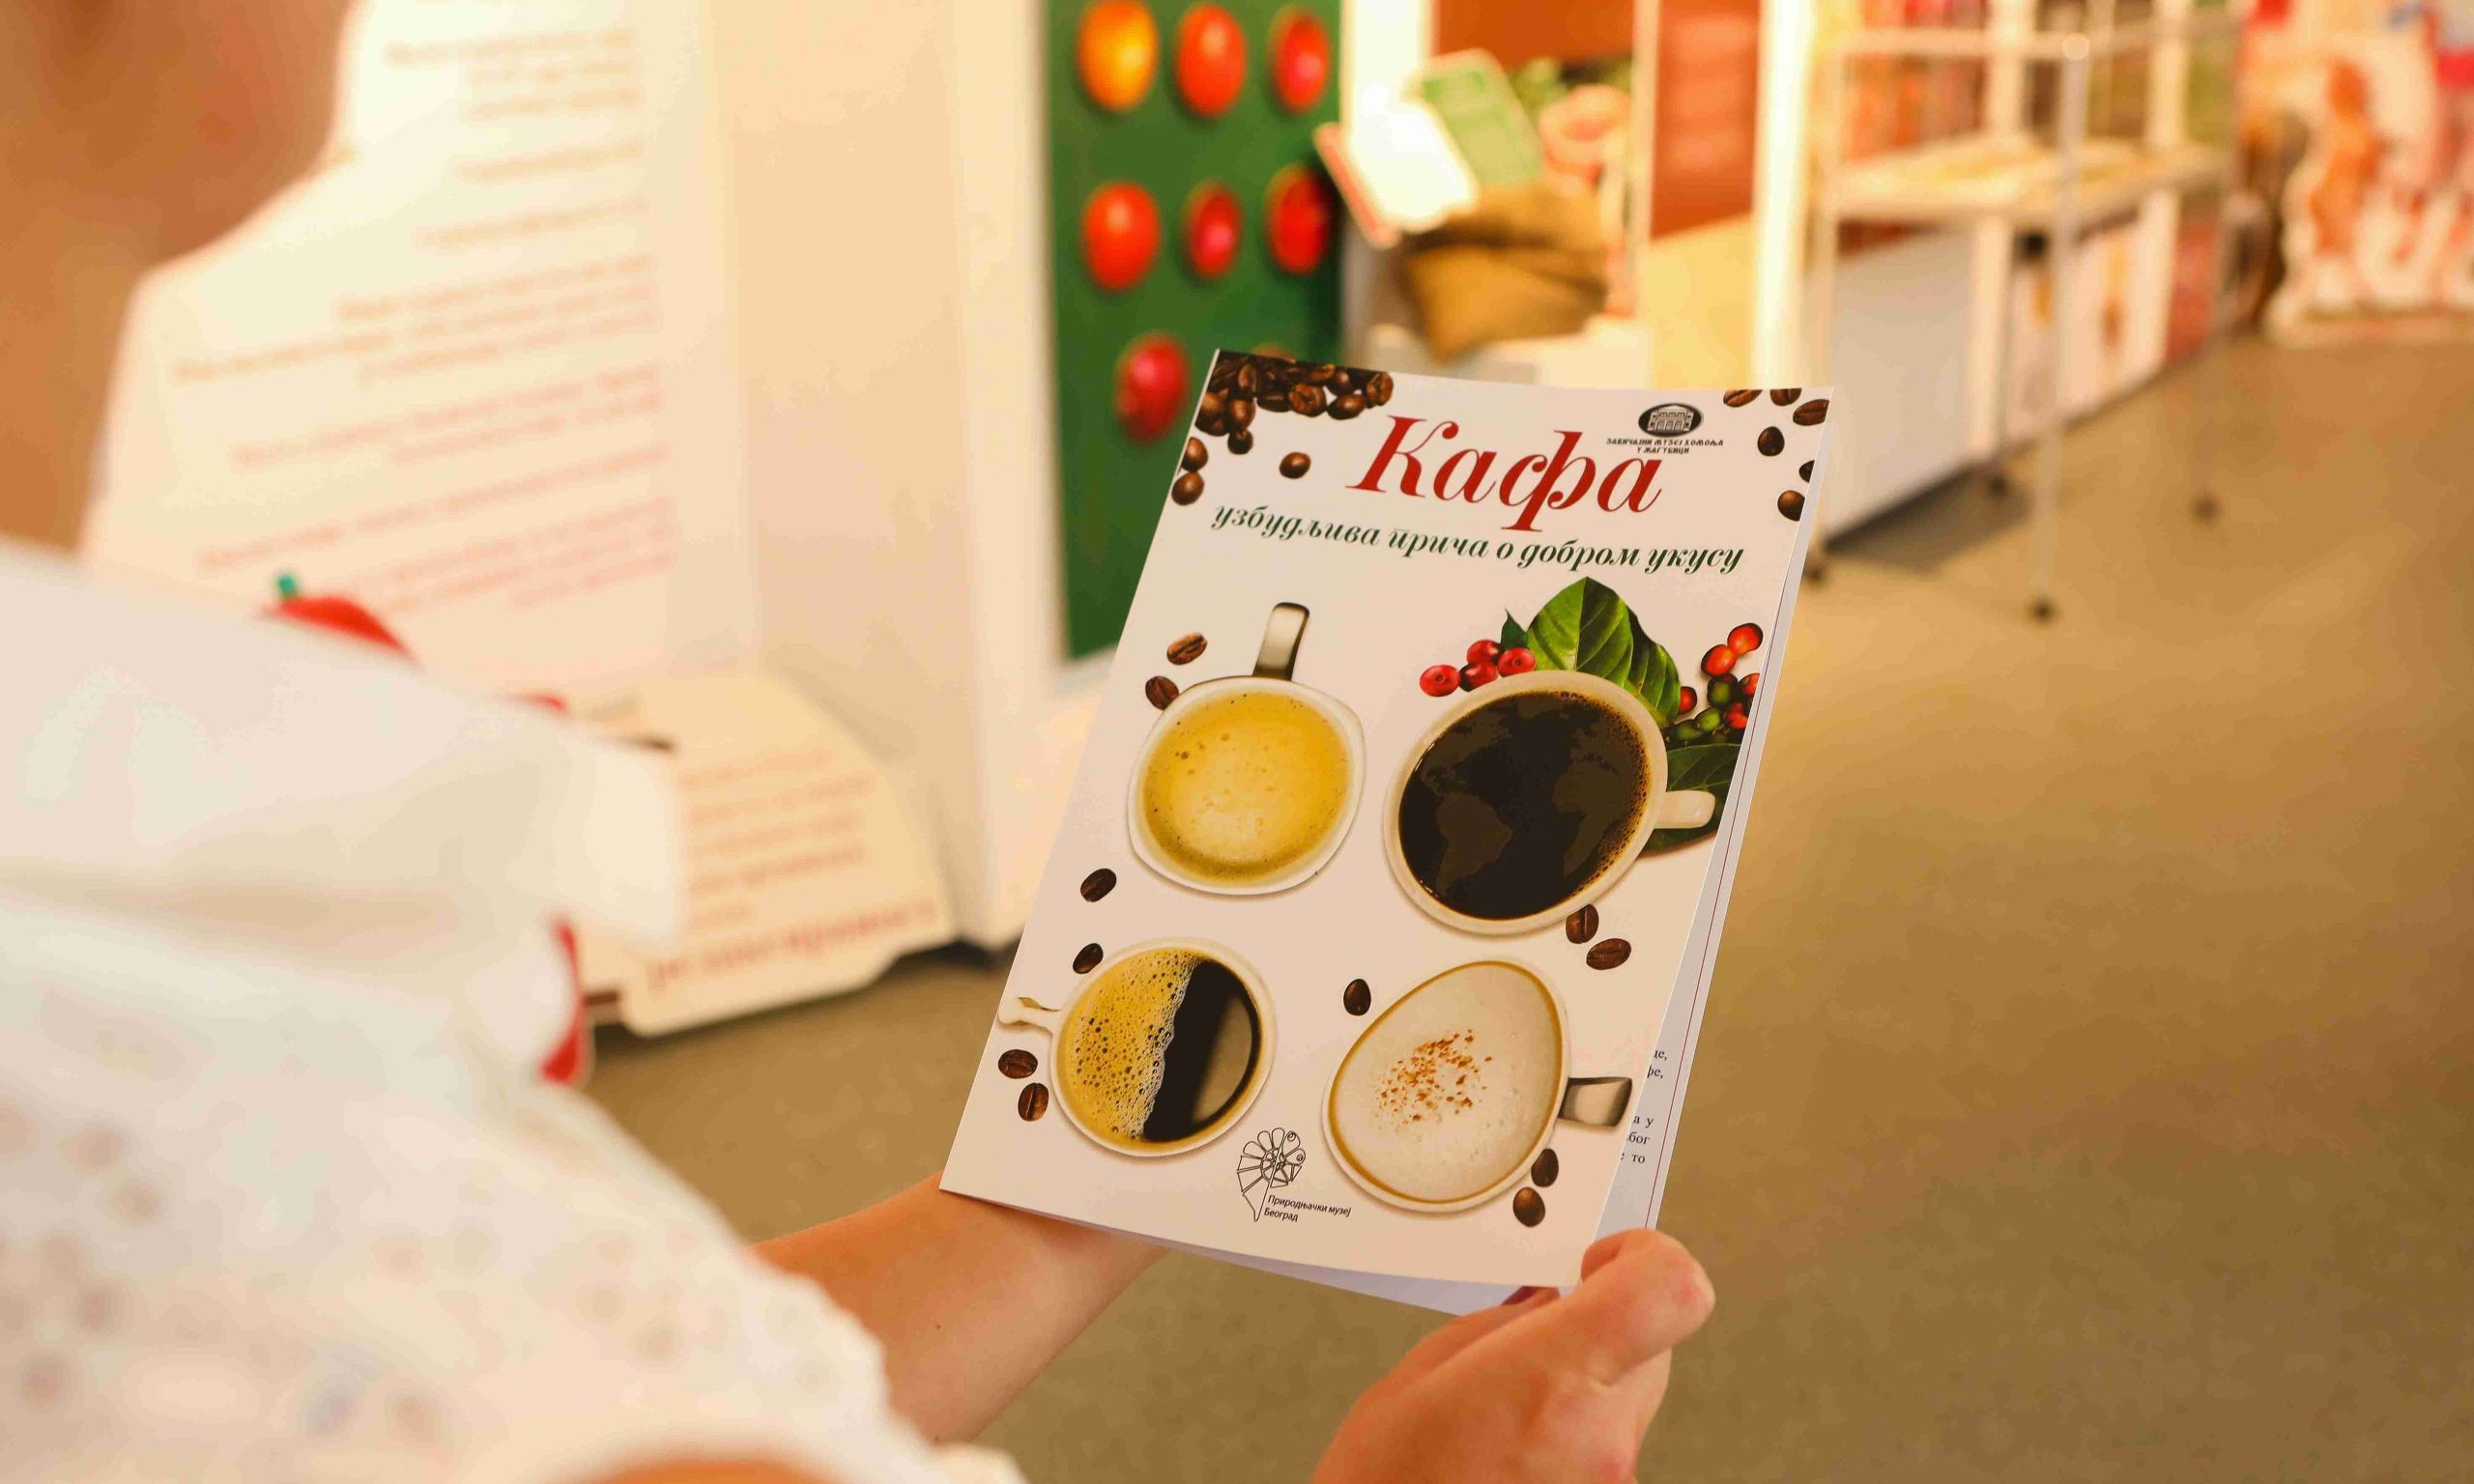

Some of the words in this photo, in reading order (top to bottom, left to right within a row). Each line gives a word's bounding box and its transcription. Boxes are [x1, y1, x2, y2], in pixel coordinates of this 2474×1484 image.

[1344, 414, 1665, 532] Кафа
[1211, 502, 1382, 549] узбудљива
[1389, 523, 1490, 558] прича
[1496, 539, 1513, 560] о
[1520, 533, 1640, 572] добром
[1645, 543, 1744, 575] укусу
[1631, 1154, 1646, 1164] то
[1263, 1207, 1299, 1222] Београд
[1267, 1194, 1328, 1213] Природњачки
[1329, 1206, 1352, 1218] музеј
